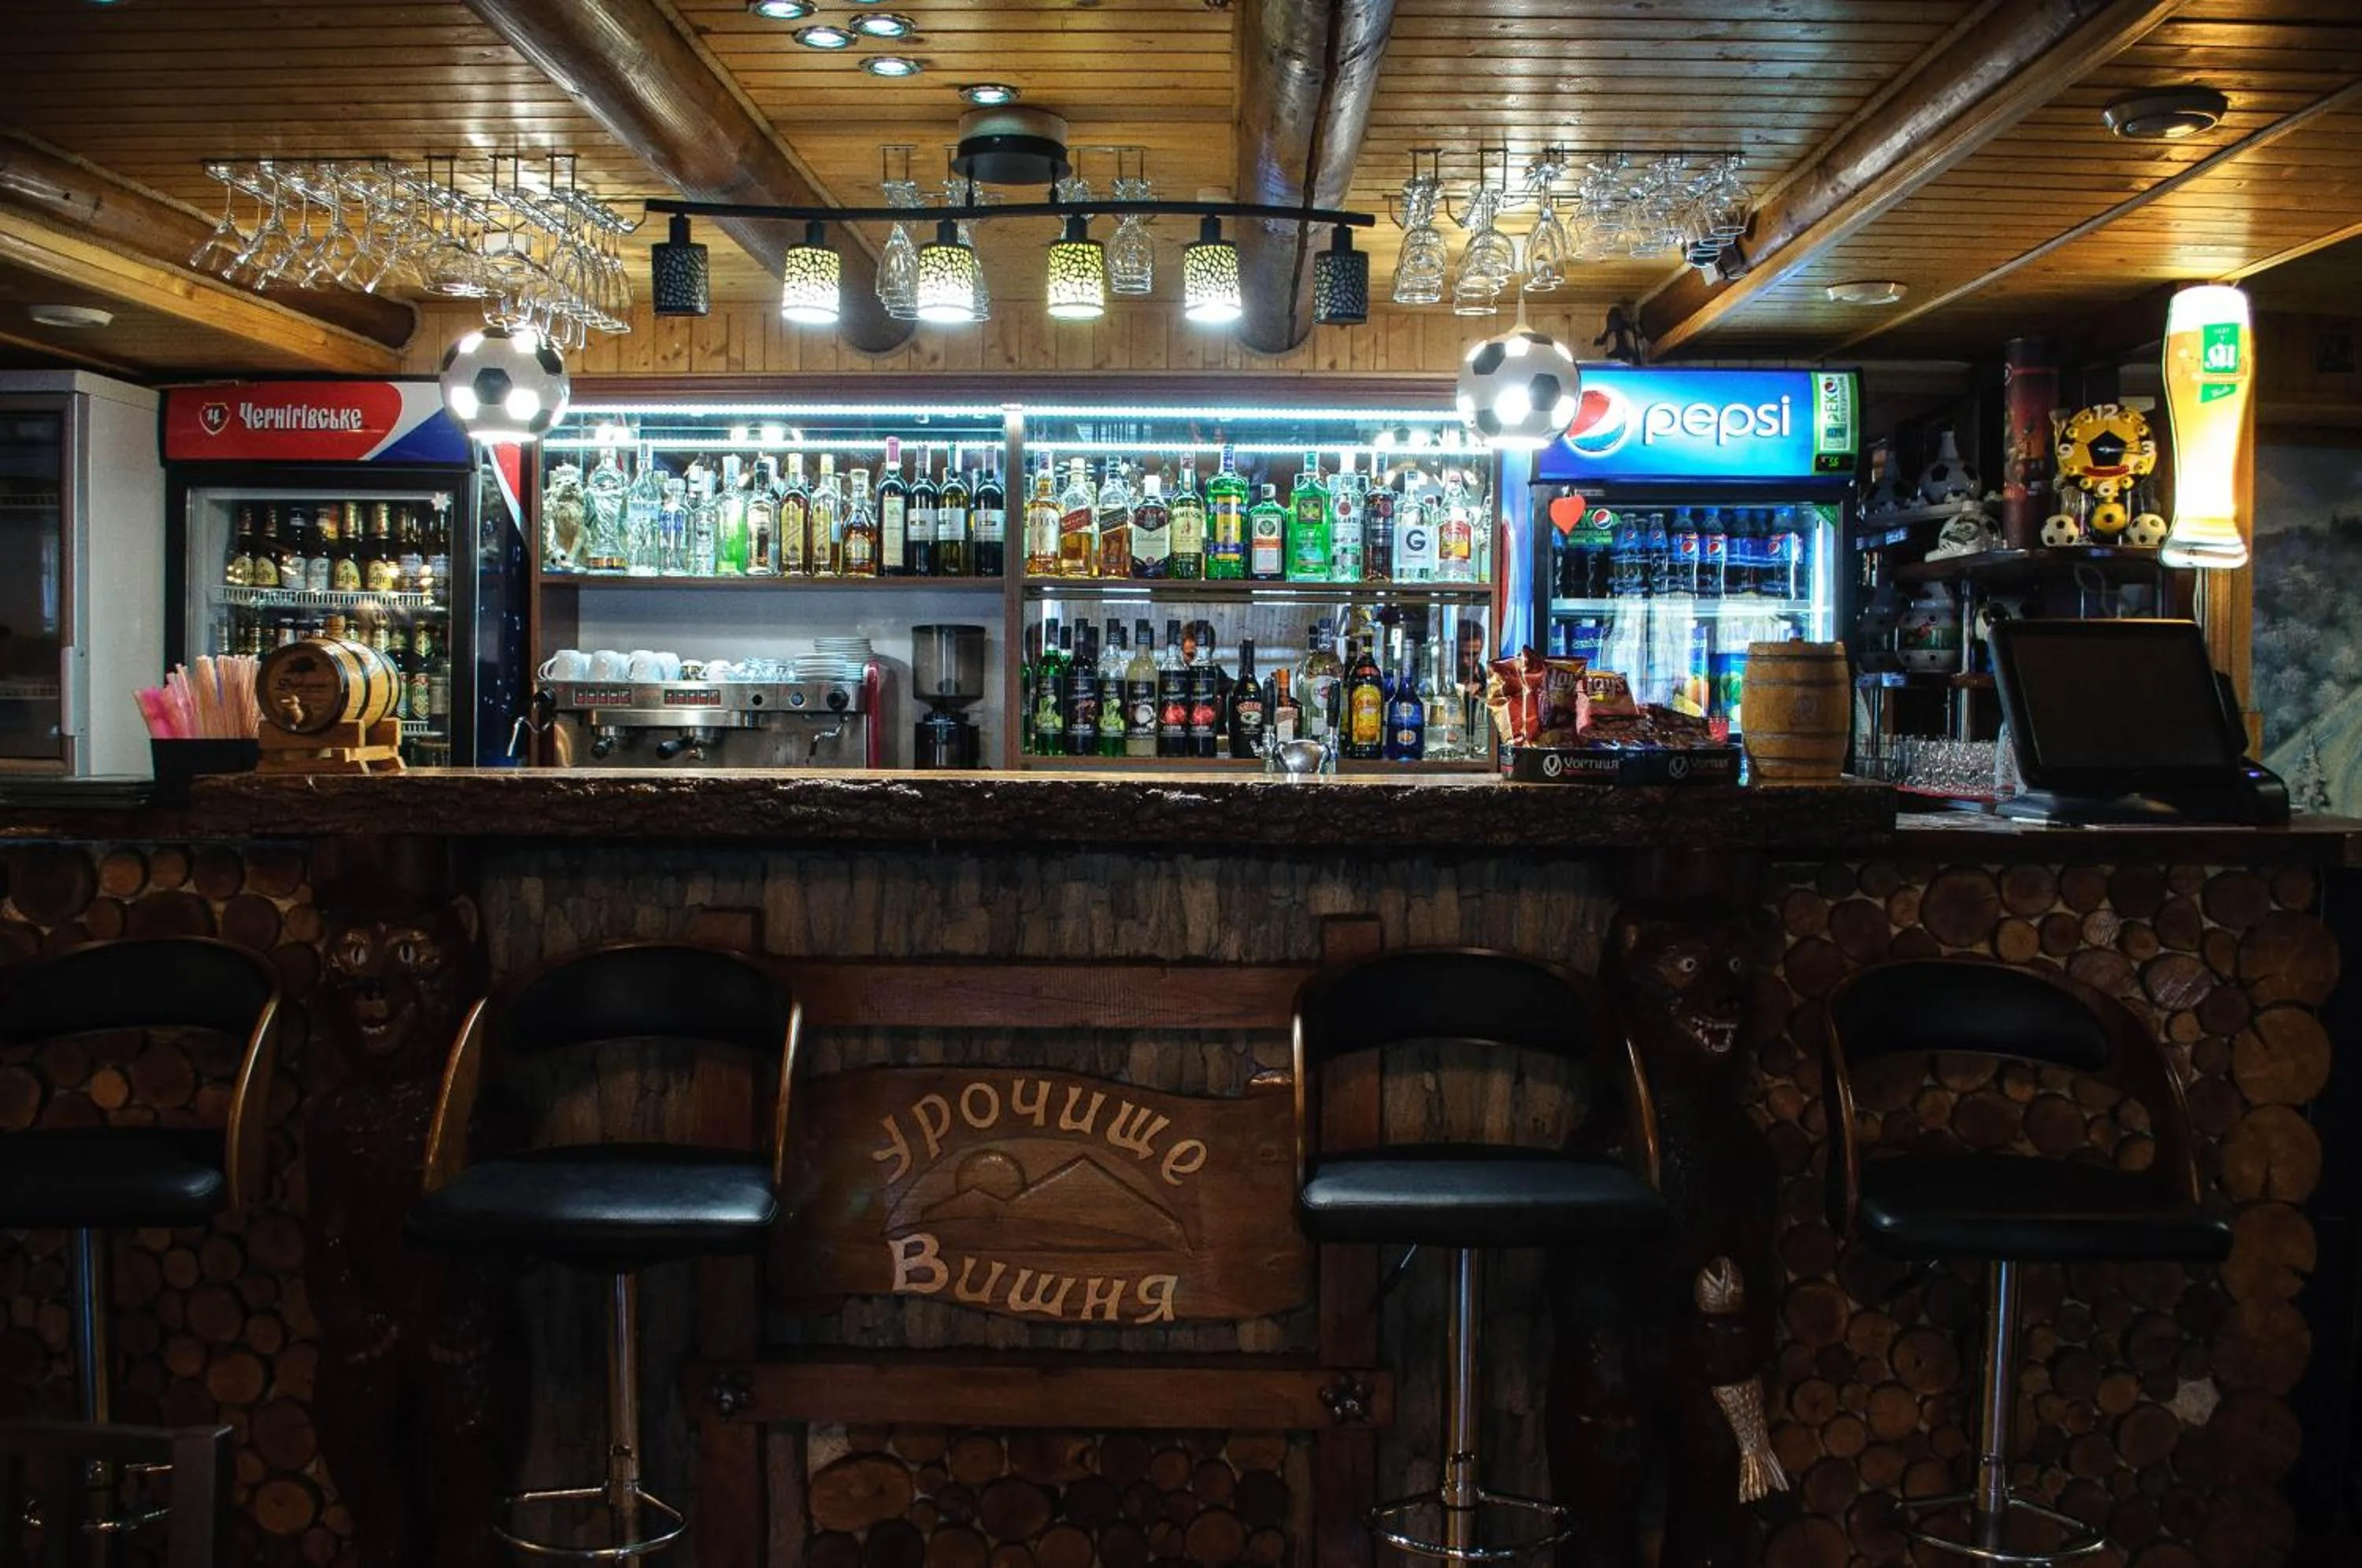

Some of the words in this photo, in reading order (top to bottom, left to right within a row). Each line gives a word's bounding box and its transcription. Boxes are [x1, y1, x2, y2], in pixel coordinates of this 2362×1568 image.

[239, 402, 363, 430] Чернігівське
[1642, 395, 1790, 446] pepsi
[2093, 404, 2119, 420] 12
[2140, 441, 2155, 455] 3
[1405, 529, 1427, 552] G
[872, 1078, 1209, 1186] Урочище
[888, 1233, 1179, 1324] Вишня
